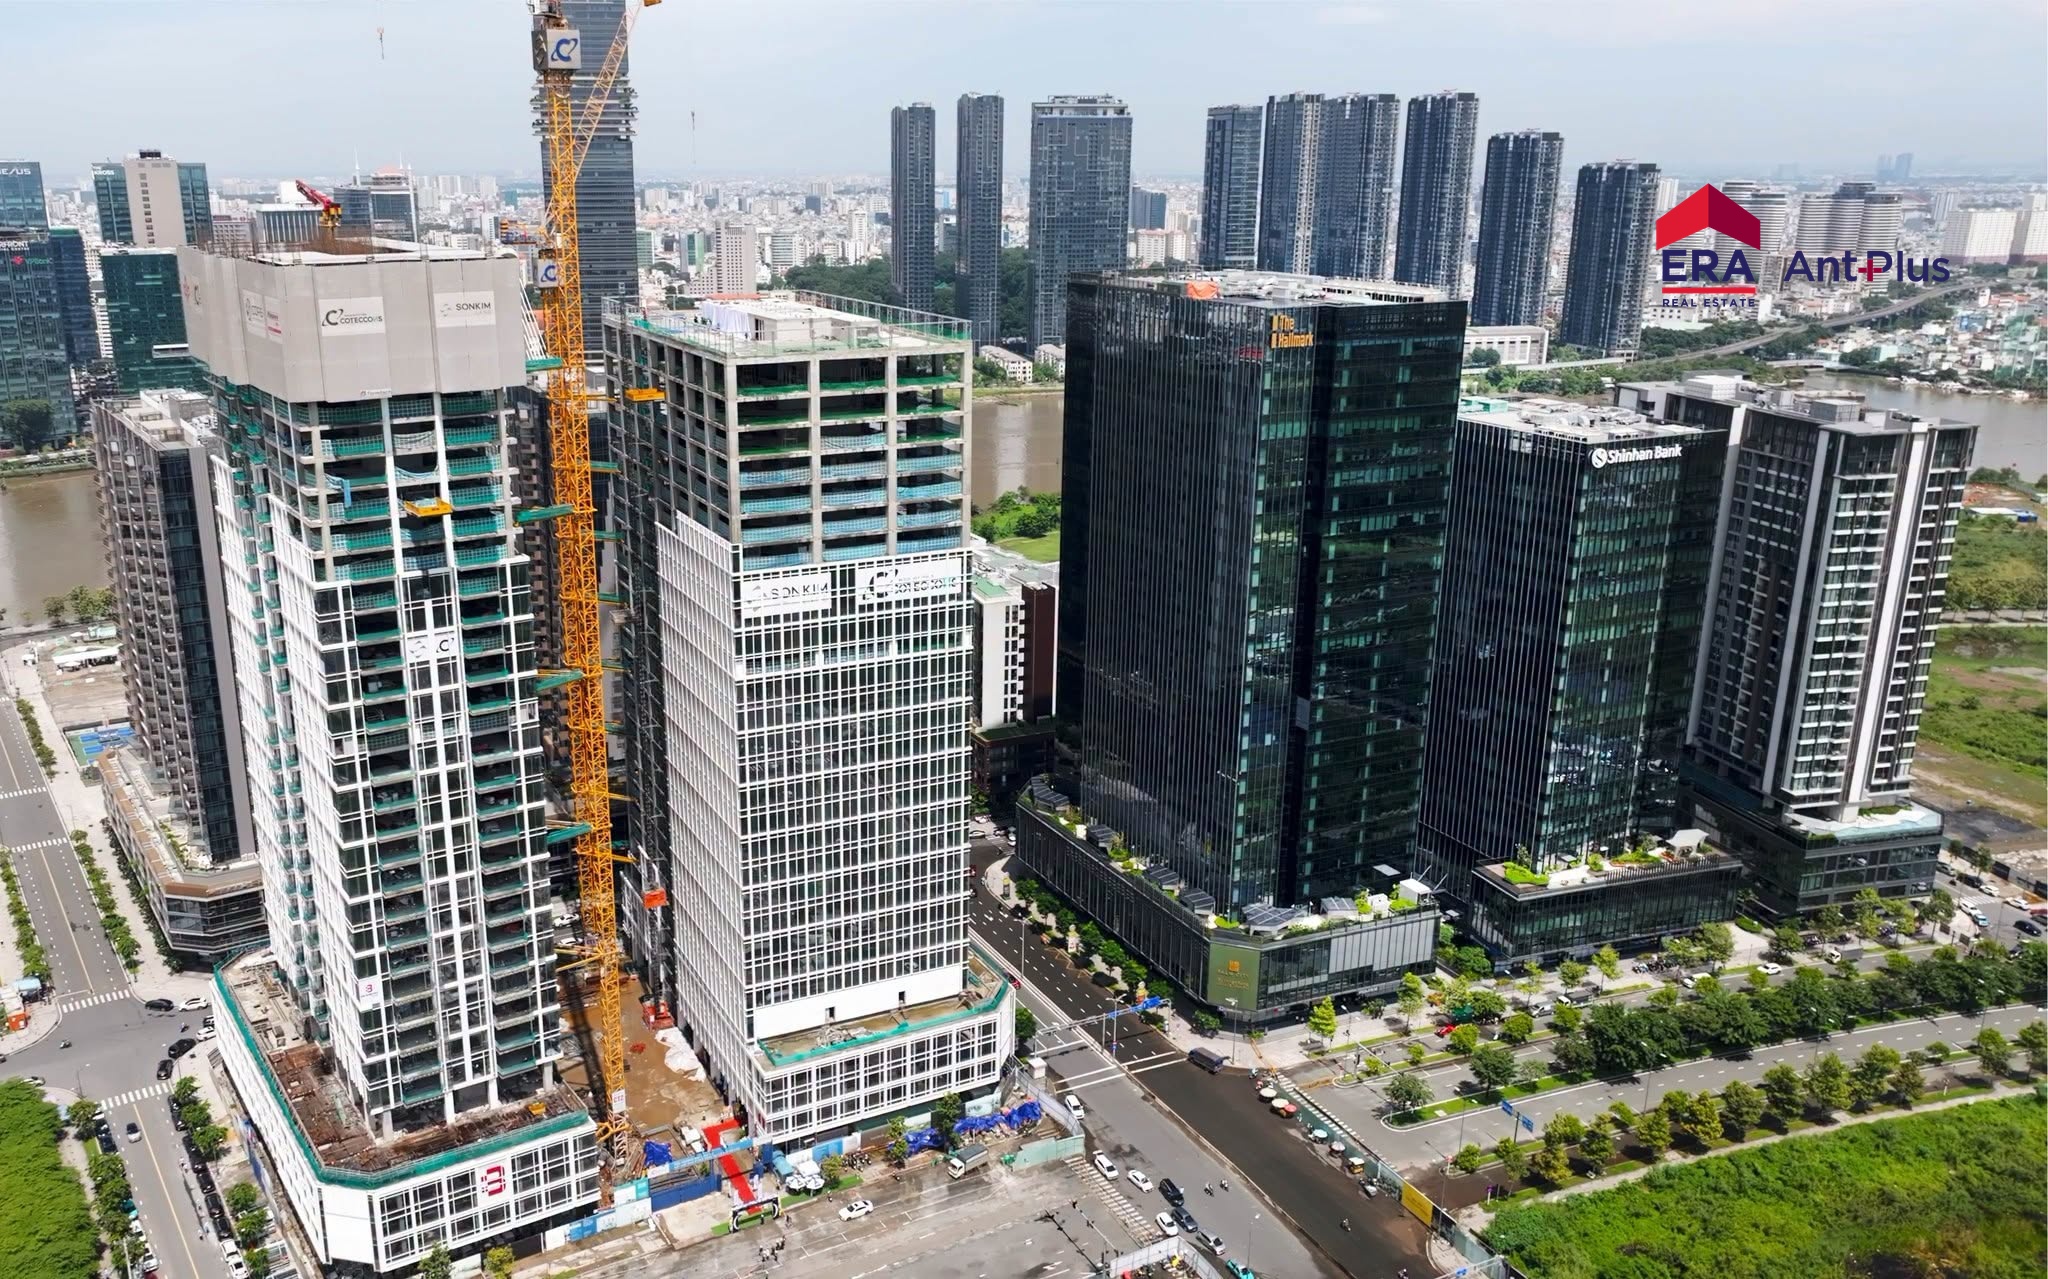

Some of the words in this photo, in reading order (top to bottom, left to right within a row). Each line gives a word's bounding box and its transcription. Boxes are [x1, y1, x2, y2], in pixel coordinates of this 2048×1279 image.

[455, 302, 492, 311] SONKIM
[1280, 315, 1294, 330] The
[1279, 332, 1313, 348] Hallmark
[1607, 448, 1653, 464] Shinhan
[1655, 443, 1682, 459] Bank
